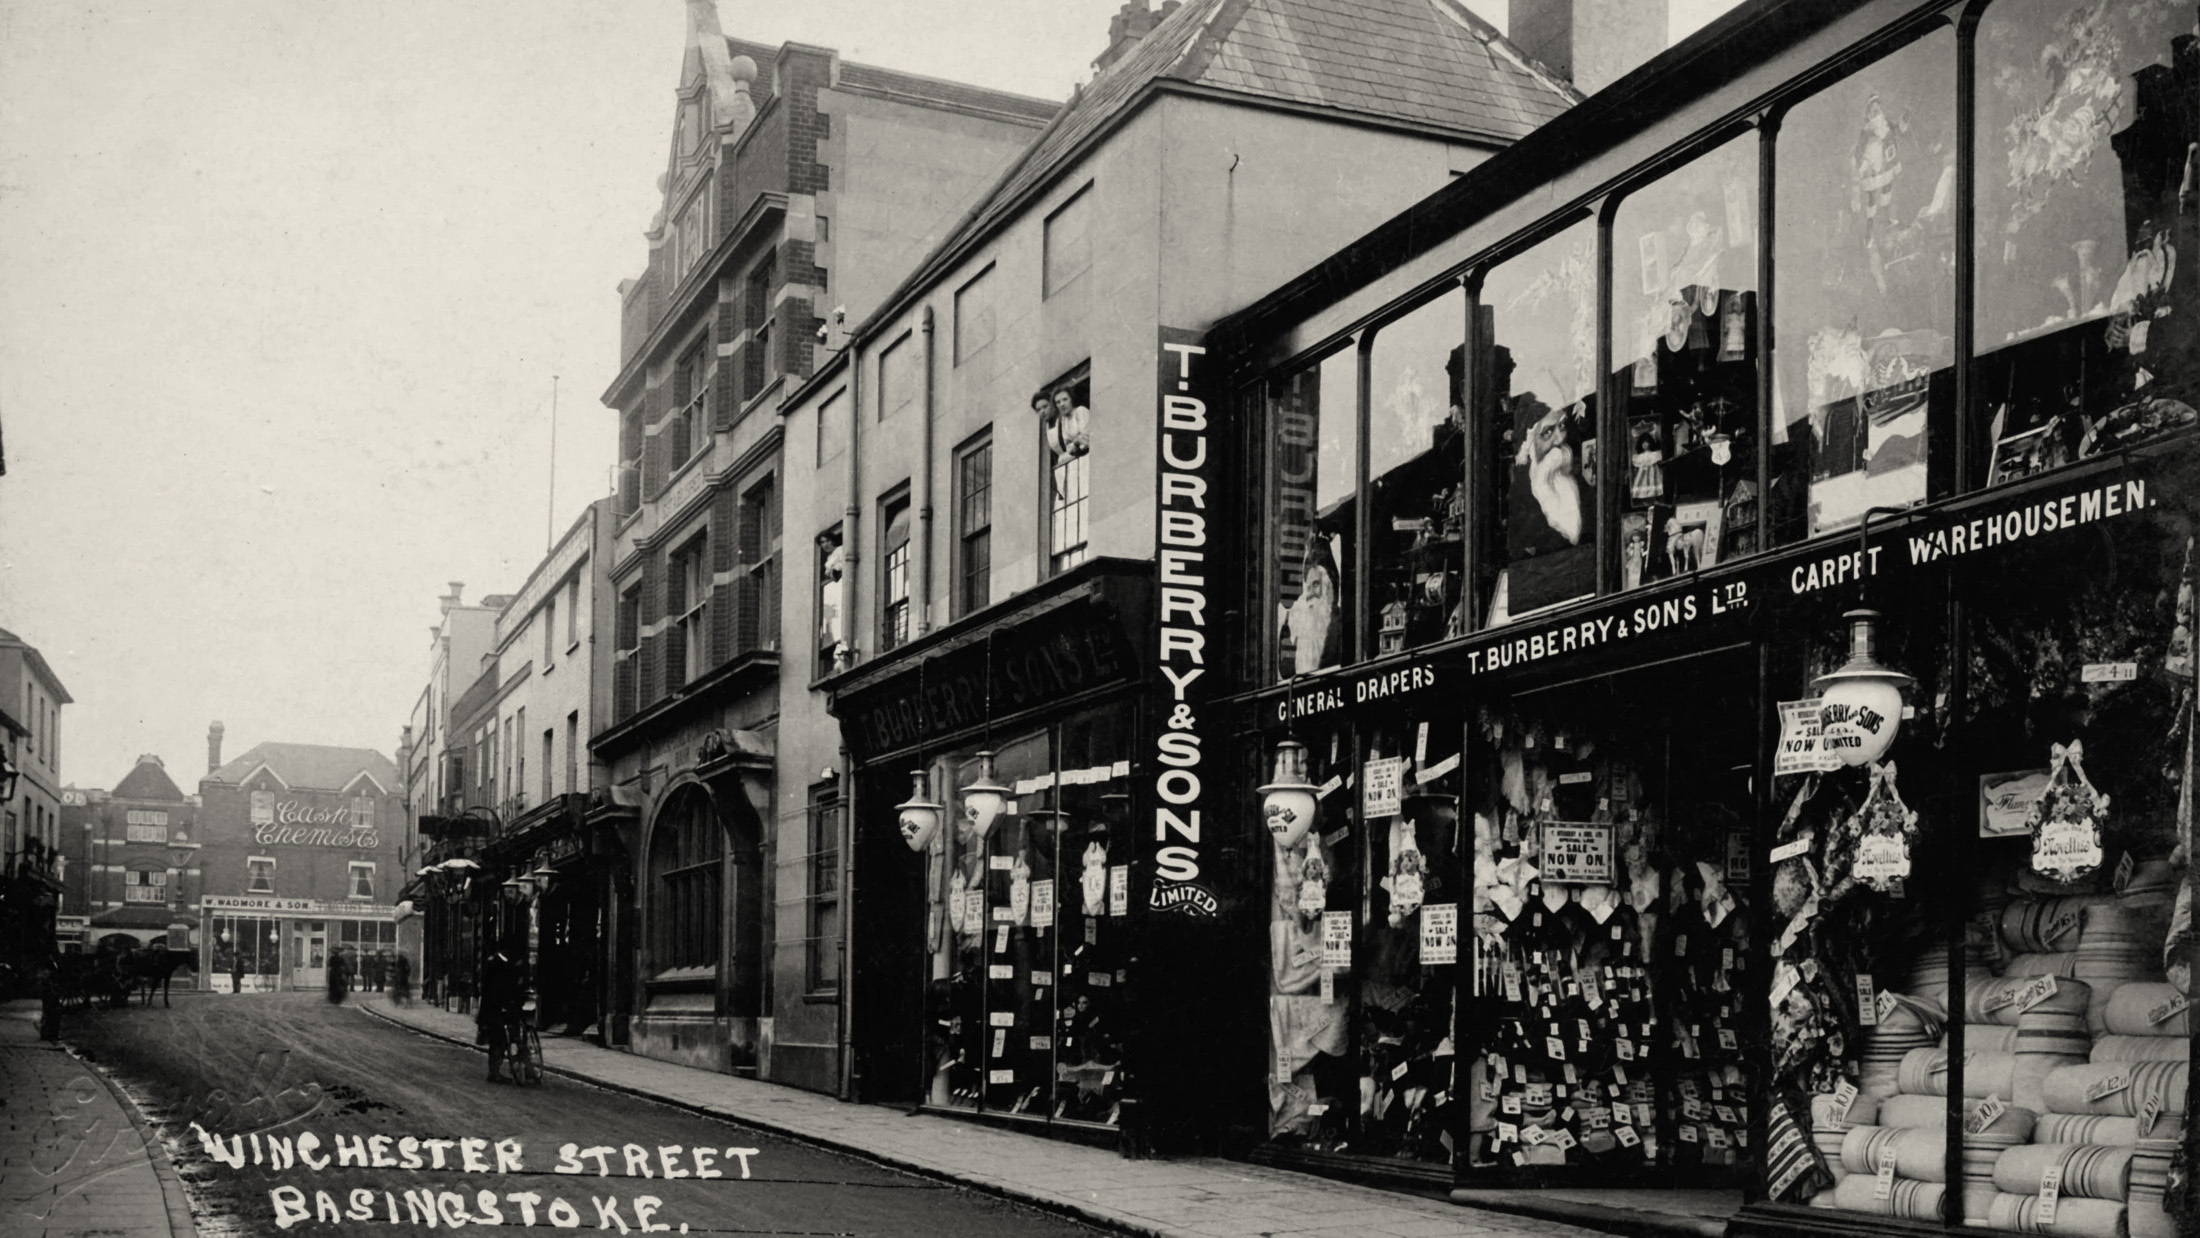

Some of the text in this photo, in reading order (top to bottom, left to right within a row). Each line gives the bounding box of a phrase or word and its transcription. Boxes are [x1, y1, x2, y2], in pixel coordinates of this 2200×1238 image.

[1908, 480, 2157, 565] WAREHOUSEMEN.
[1617, 619, 1629, 638] &
[1634, 595, 1698, 633] SONS
[1356, 664, 1435, 704] DRAPERS
[2109, 665, 2119, 678] 4
[1856, 706, 1884, 735] SONS
[1784, 739, 1816, 753] NOW
[276, 800, 351, 824] Cash
[1155, 731, 1202, 881] SONS
[255, 821, 379, 848] Chemists
[1566, 843, 1588, 853] SALE
[1547, 853, 1578, 866] NOW
